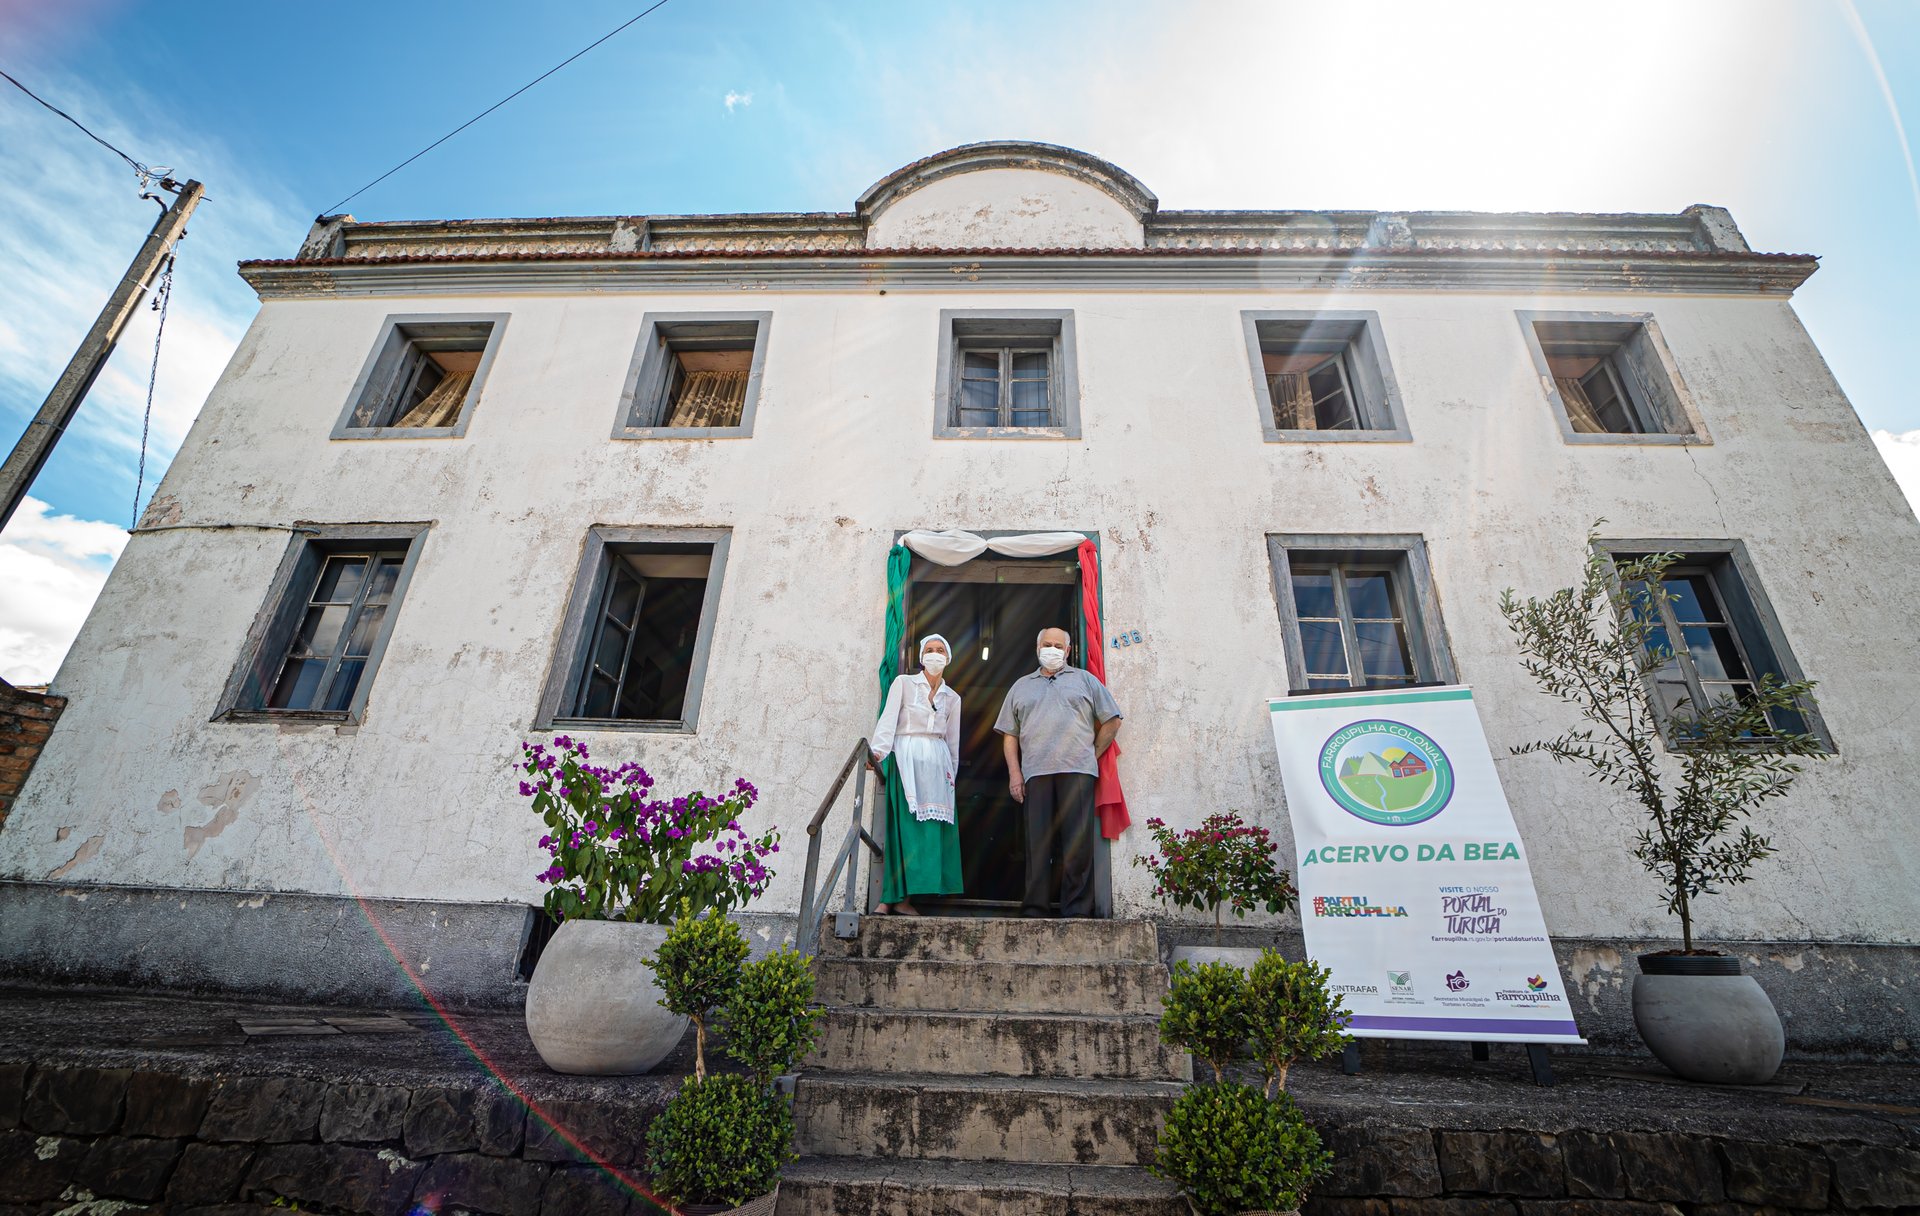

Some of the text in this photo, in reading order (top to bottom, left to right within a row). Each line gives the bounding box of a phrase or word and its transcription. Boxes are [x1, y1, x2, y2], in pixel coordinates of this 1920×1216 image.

[1111, 630, 1142, 649] 436
[1323, 724, 1443, 768] FARROUPILHA COLONIAL
[1302, 842, 1521, 867] ACERVO DA BEA
[1313, 896, 1368, 907] #PARTIU
[1441, 893, 1496, 913] PORTAL
[1315, 906, 1409, 917] FARROUPILHA
[1497, 907, 1507, 916] DO
[1443, 914, 1501, 934] TURISTA
[1331, 984, 1379, 993] SINTRAFAR
[1495, 991, 1561, 1003] Farroupilha
